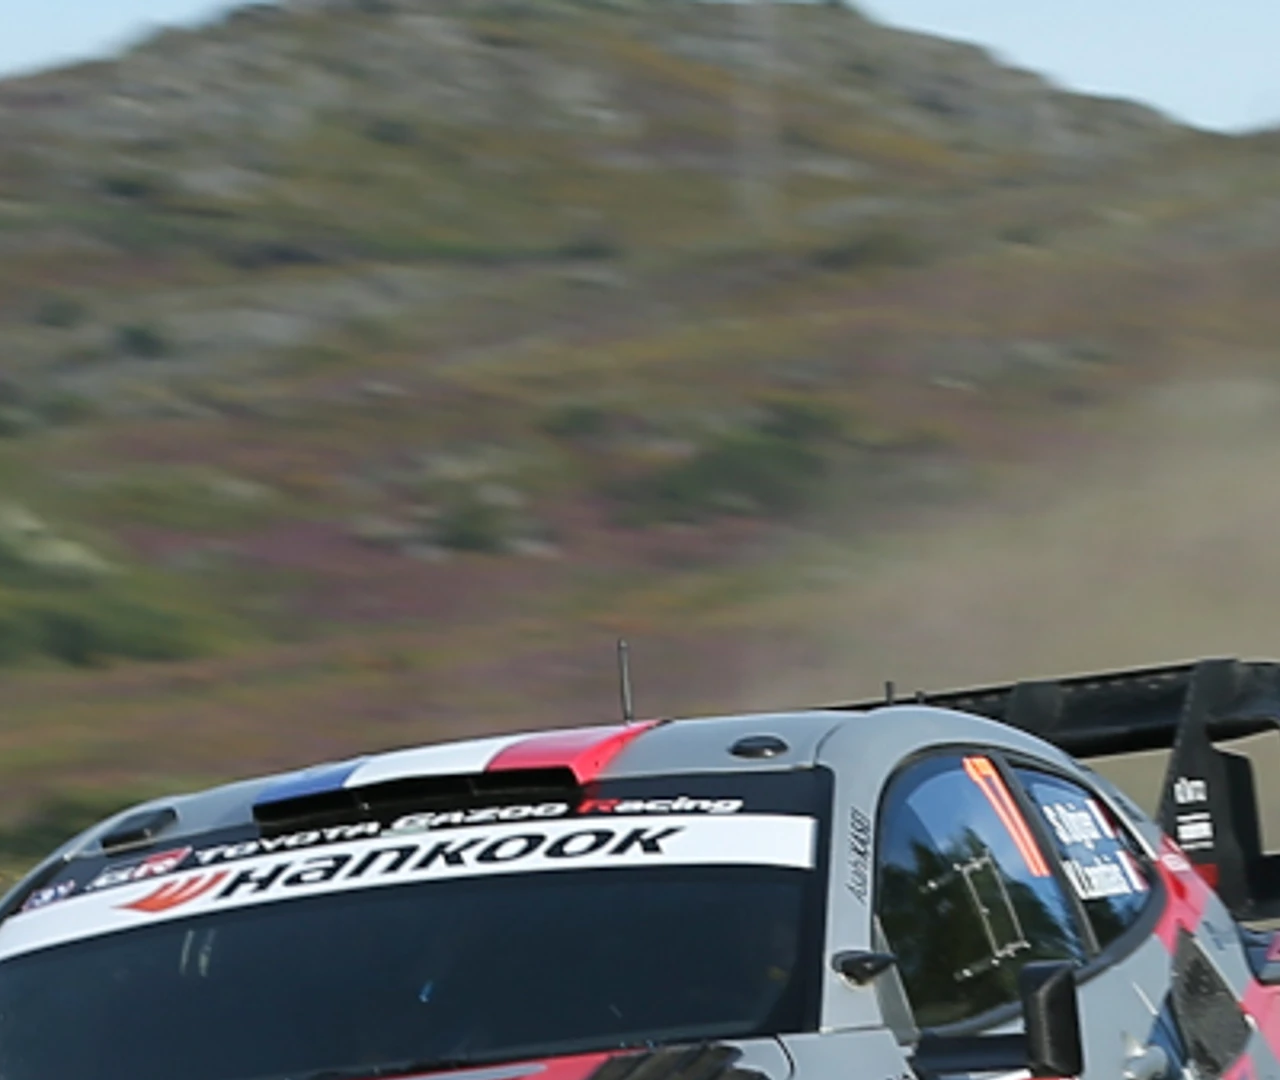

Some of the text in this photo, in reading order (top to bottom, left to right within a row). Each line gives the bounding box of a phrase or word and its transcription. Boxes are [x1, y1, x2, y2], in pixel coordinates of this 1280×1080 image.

[196, 820, 381, 864] TOYOTA
[391, 801, 570, 832] GAZOO
[576, 795, 745, 814] Racing
